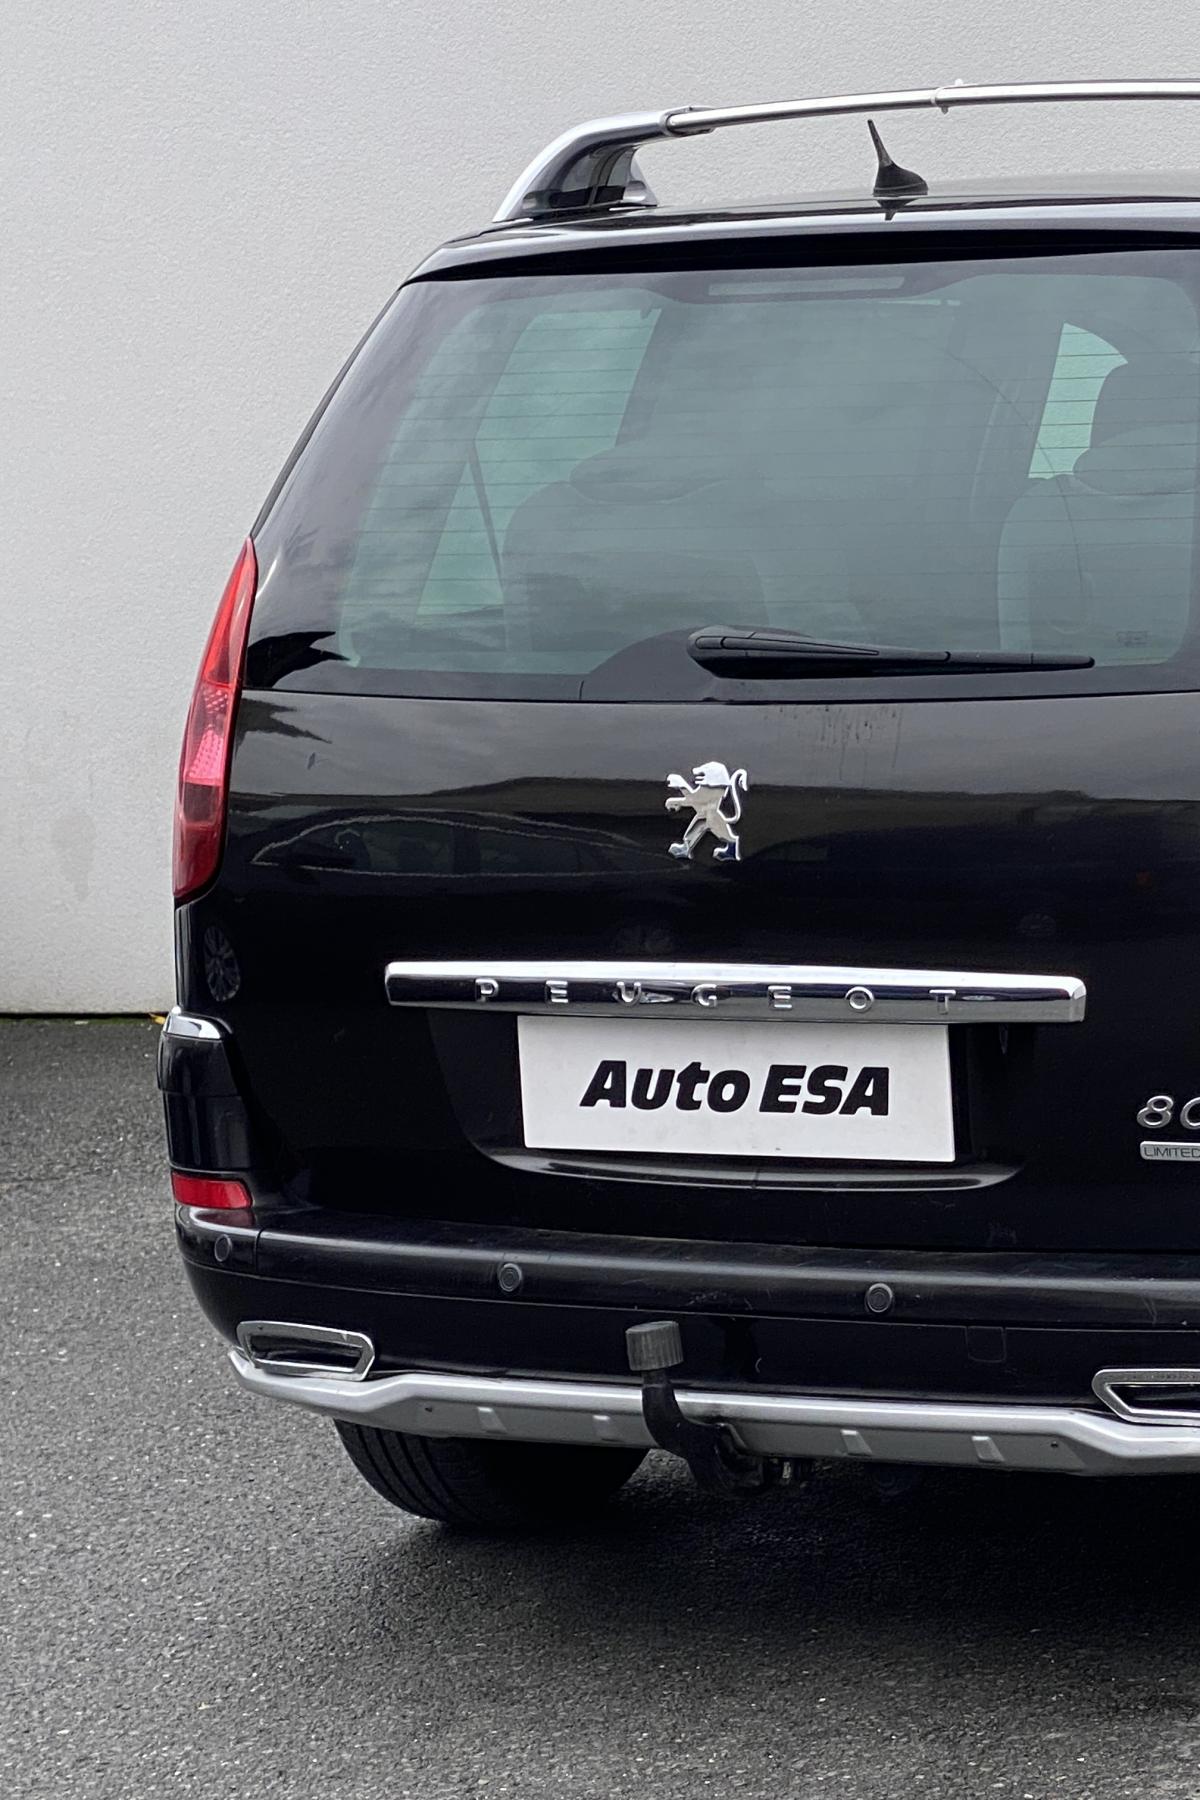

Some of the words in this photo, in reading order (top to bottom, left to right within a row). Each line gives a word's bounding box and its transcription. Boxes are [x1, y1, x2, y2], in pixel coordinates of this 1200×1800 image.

[475, 978, 956, 1014] PEUGEOT
[579, 1060, 751, 1113] Auto
[758, 1064, 890, 1116] ESA
